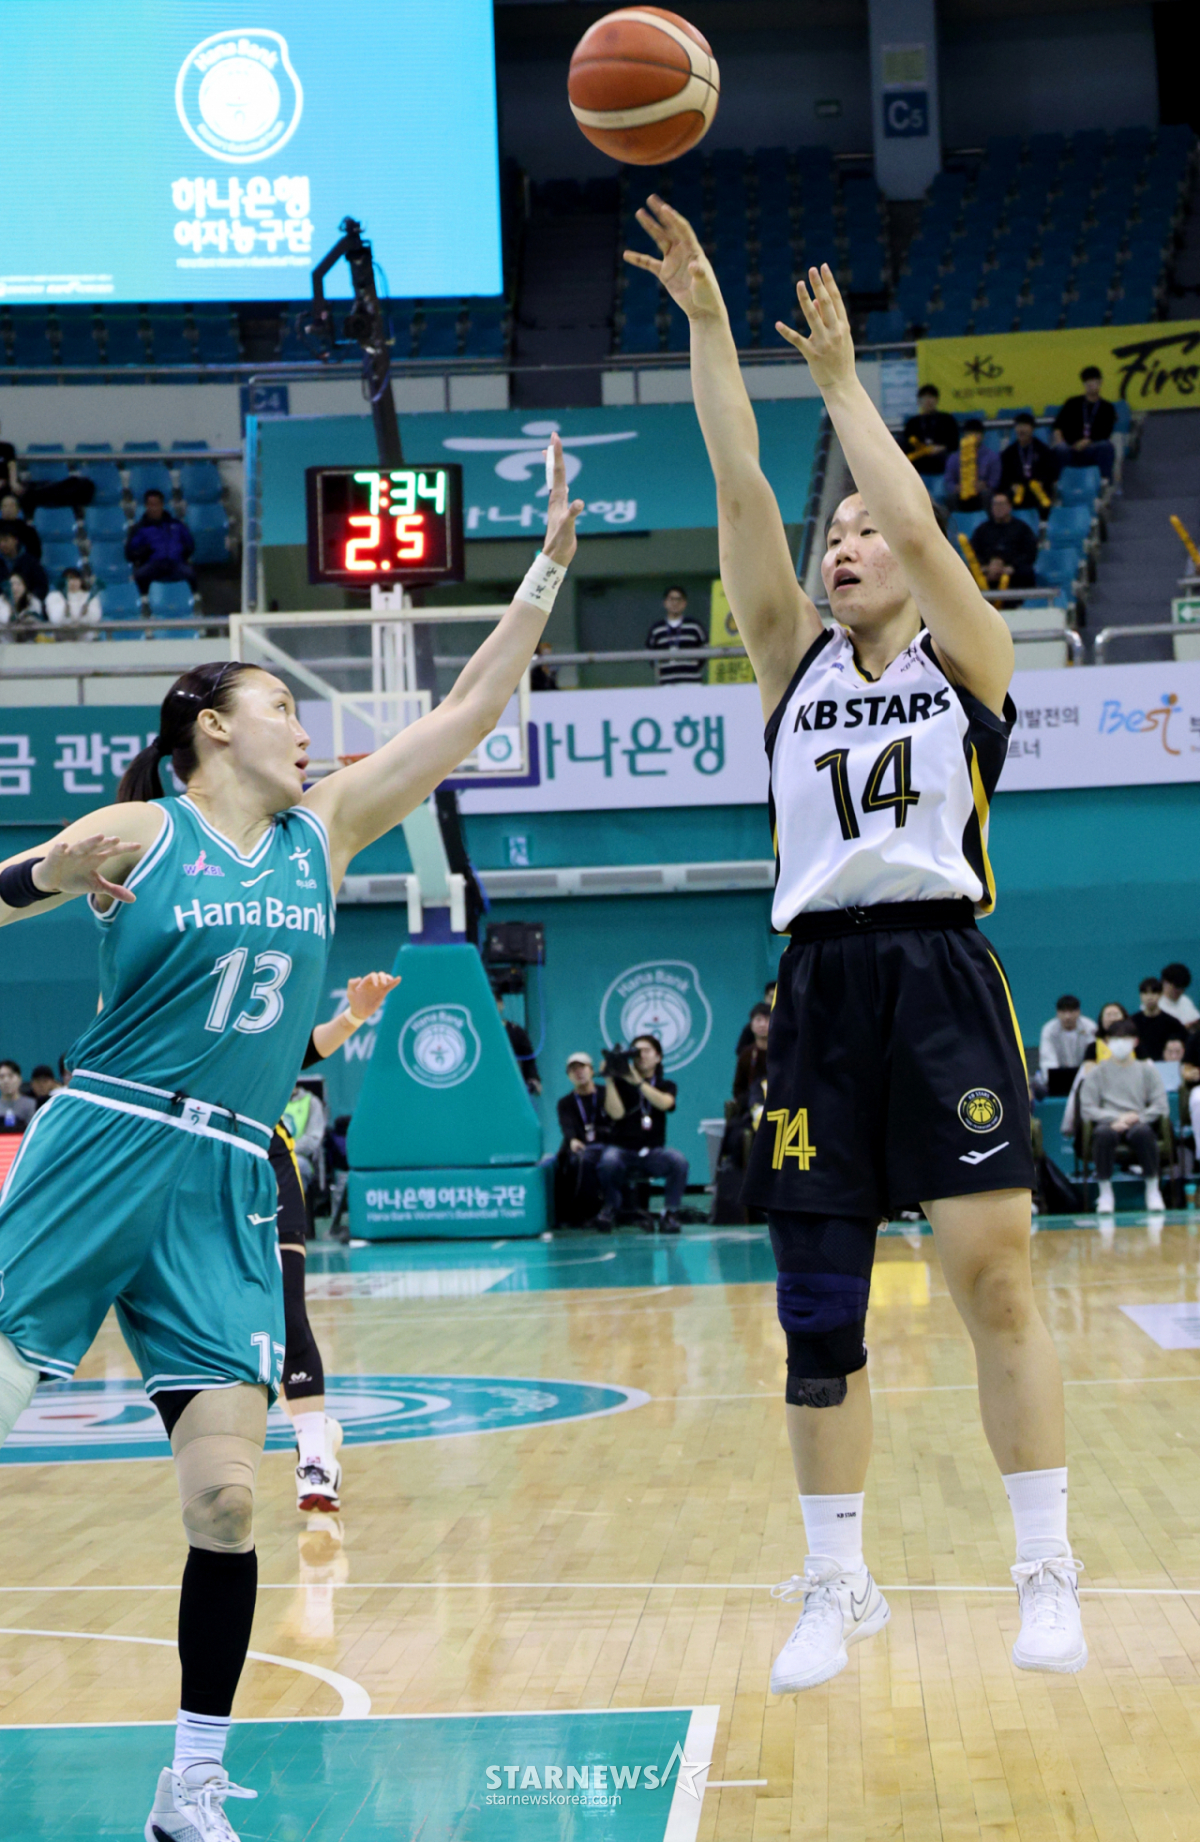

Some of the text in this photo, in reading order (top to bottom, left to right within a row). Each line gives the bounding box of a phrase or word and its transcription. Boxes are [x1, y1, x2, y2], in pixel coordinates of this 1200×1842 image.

[171, 175, 311, 219] 하나은행
[173, 218, 315, 254] 여자농구단
[353, 470, 447, 516] 7:34
[344, 514, 425, 572] 2.5
[793, 686, 951, 733] KB STARS
[814, 735, 921, 841] 14
[204, 947, 292, 1034] 13
[766, 1107, 817, 1170] 14
